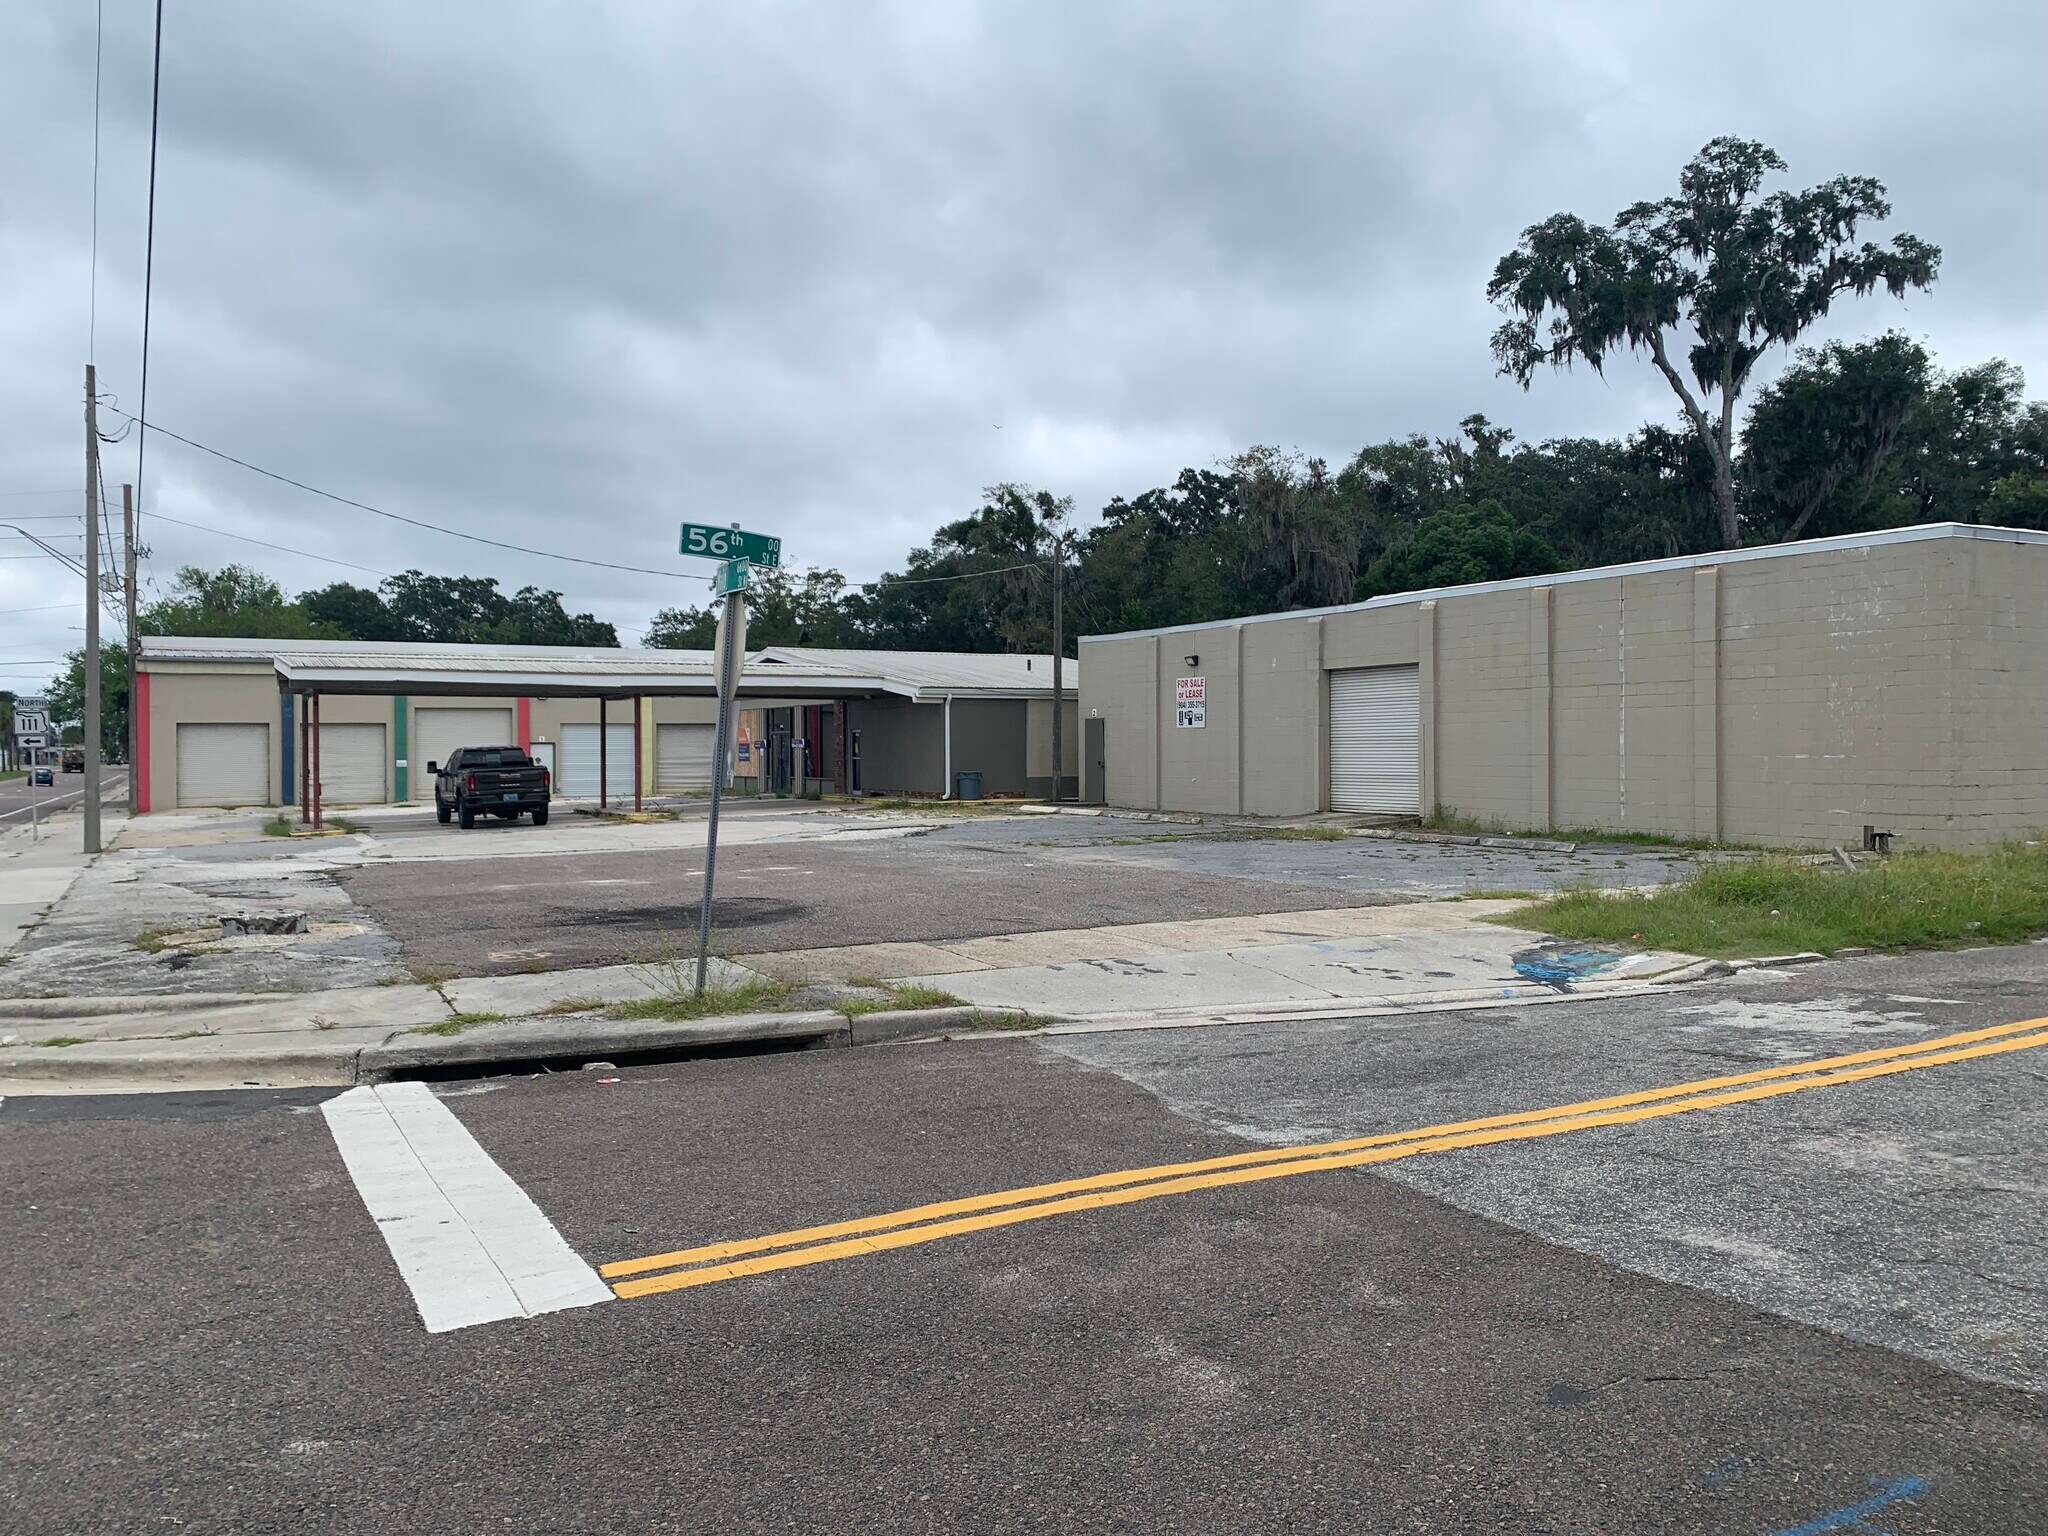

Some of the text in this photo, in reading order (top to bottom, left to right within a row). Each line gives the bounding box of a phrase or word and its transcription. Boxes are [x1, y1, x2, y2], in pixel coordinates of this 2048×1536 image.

[688, 528, 743, 554] 56th
[762, 552, 778, 566] St E
[1177, 678, 1204, 688] FOR SALE
[1185, 689, 1203, 698] LEASE
[18, 699, 44, 707] NORTH
[22, 718, 38, 731] 111
